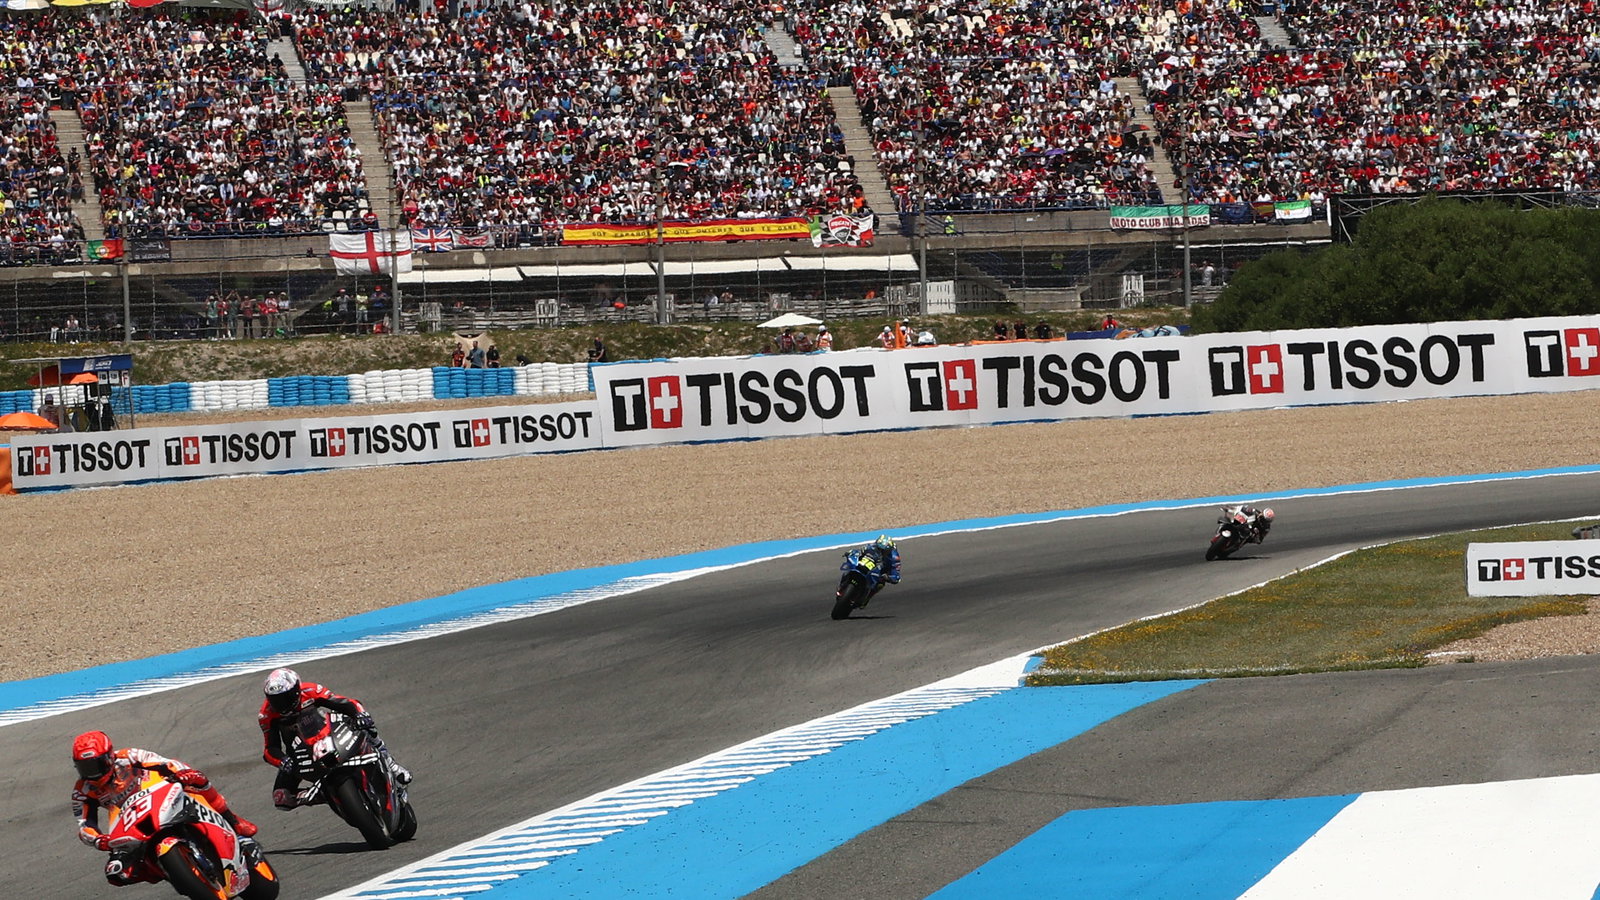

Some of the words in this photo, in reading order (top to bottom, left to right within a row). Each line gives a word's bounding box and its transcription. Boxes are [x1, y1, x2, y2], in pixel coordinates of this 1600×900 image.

[1111, 217, 1136, 228] MOTO
[1140, 218, 1161, 228] CLUB
[983, 350, 1180, 408] TISSOT
[1287, 334, 1495, 391] TISSOT
[686, 365, 876, 427] TISSOT
[347, 422, 441, 454] TISSOT
[492, 412, 593, 444] TISSOT
[53, 440, 151, 474] TISSOT
[202, 431, 297, 463] TISSOT
